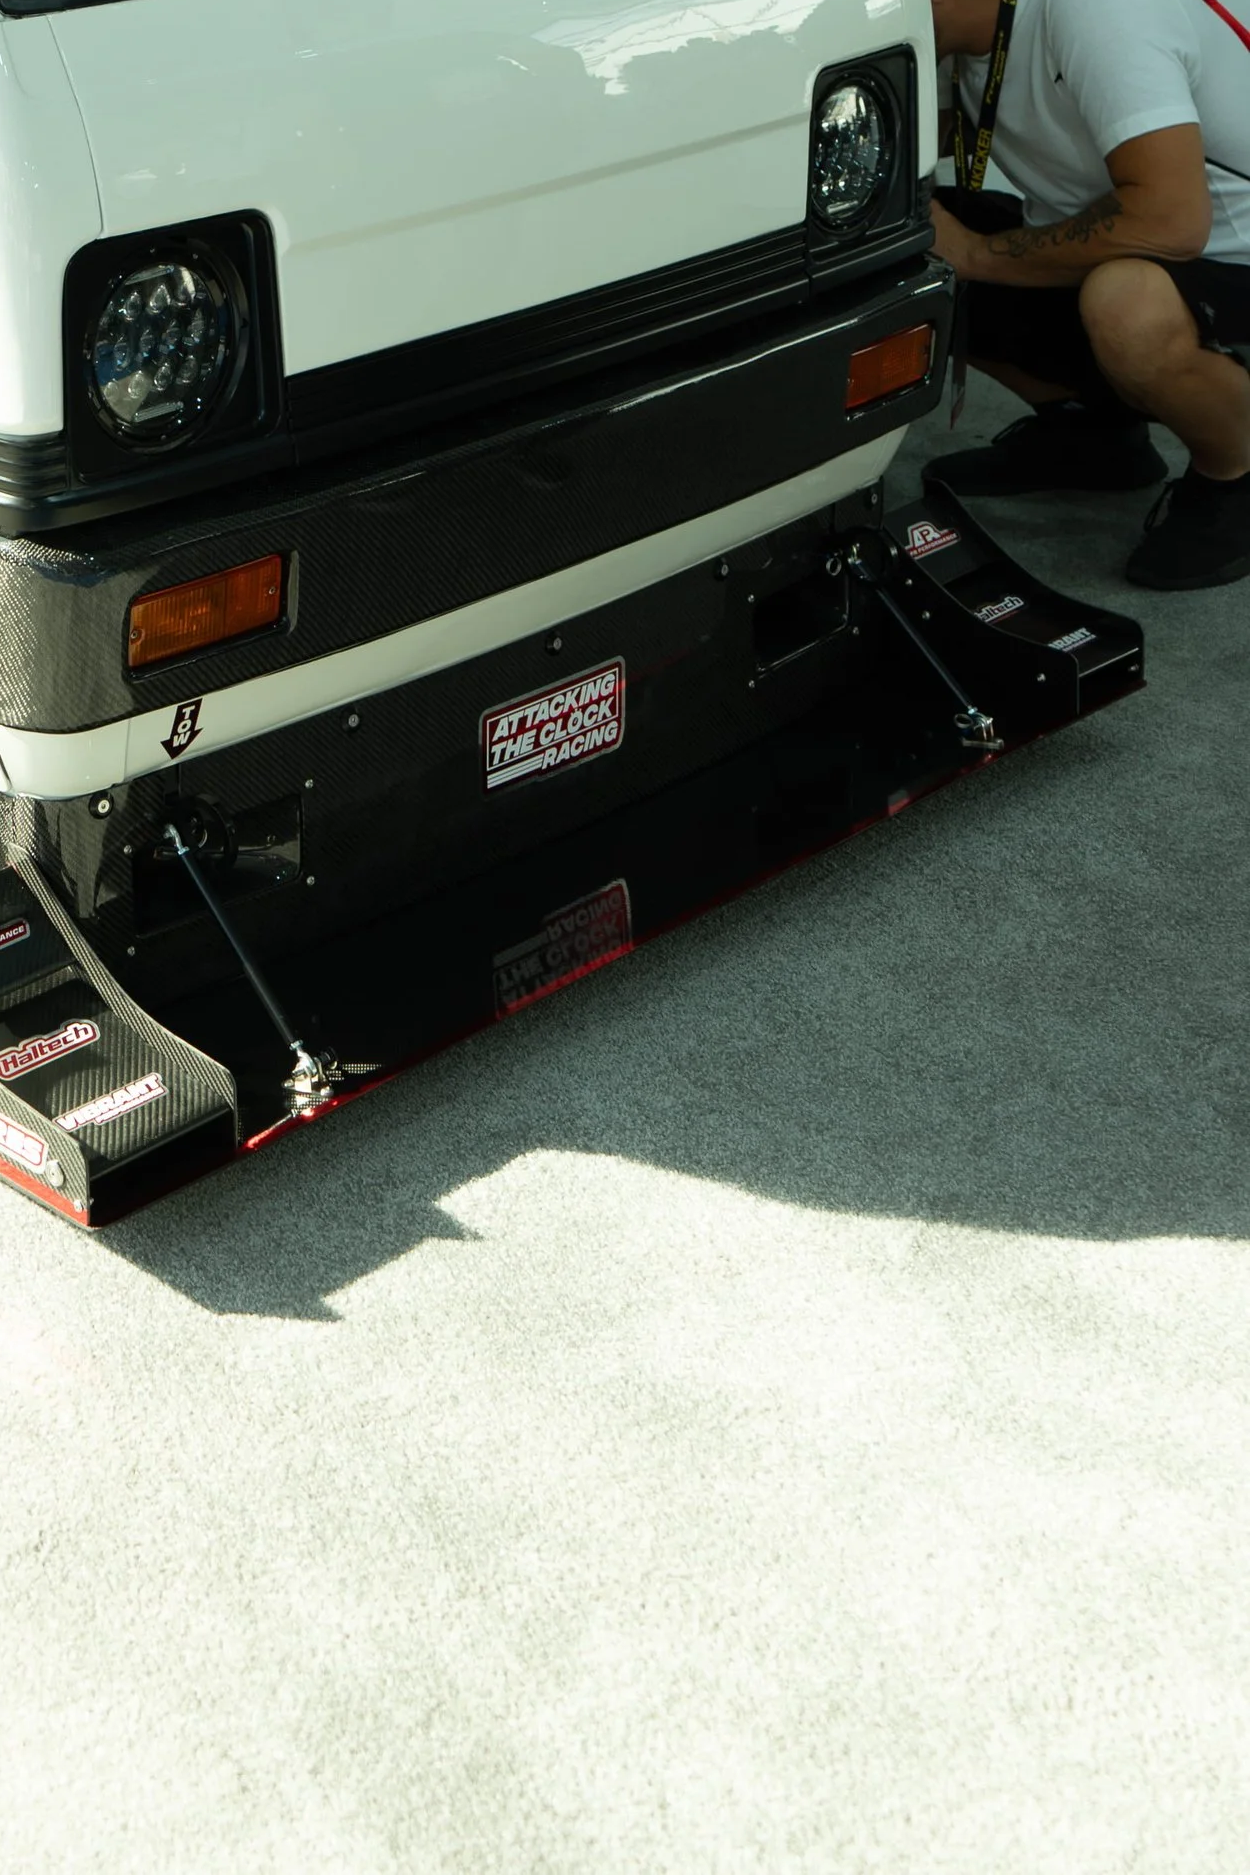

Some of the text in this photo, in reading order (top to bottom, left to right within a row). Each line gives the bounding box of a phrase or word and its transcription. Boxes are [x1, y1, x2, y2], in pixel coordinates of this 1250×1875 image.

[974, 596, 1023, 622] altech
[172, 704, 196, 748] TOW
[490, 696, 615, 766] THE CLOCK
[491, 673, 616, 743] ATTACKING
[541, 720, 619, 770] RACING
[1, 1024, 90, 1073] Haltech
[56, 1074, 161, 1131] VIBRANT
